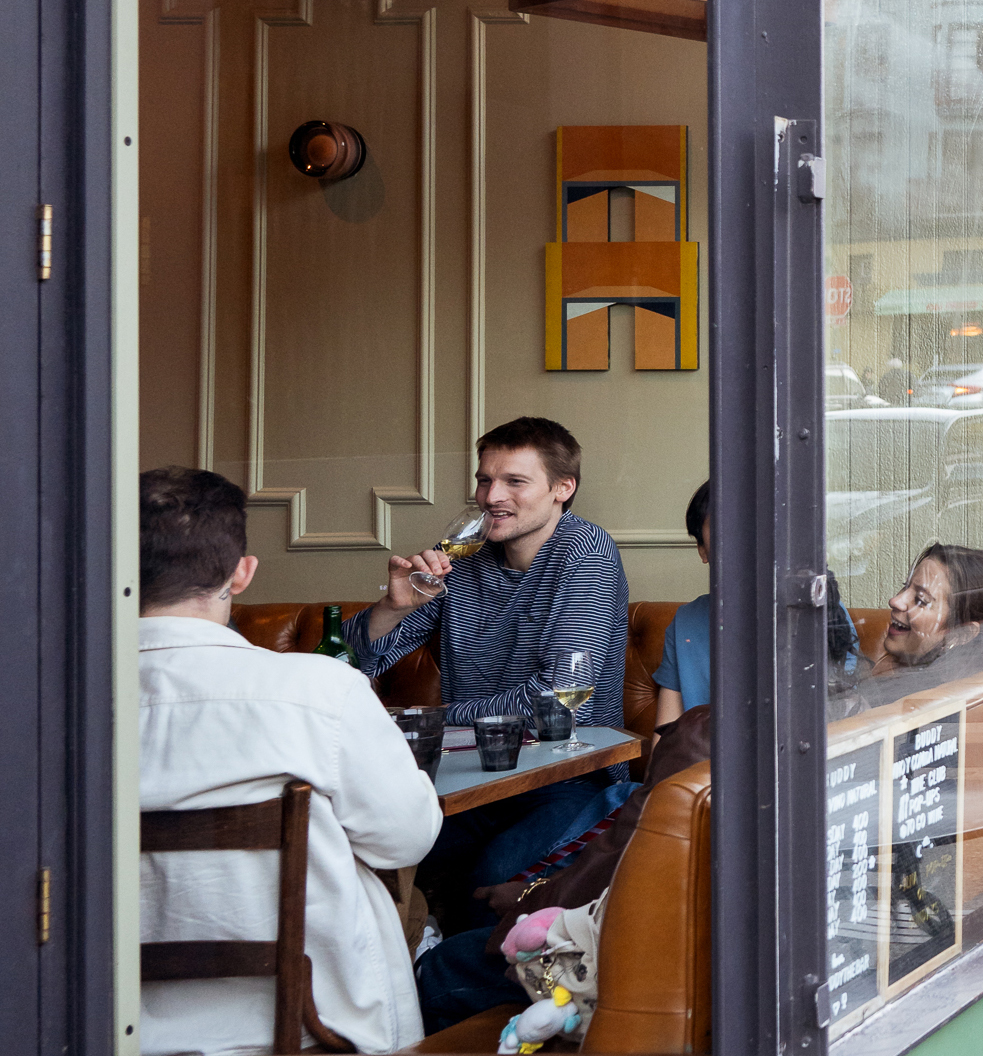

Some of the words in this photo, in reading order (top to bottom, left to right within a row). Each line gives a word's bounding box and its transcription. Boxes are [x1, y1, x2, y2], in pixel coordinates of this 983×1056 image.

[914, 725, 942, 751] BUDDY
[826, 763, 857, 789] UDDY
[927, 765, 947, 788] CLUB
[908, 786, 941, 816] POP-UPS
[915, 812, 927, 832] GO
